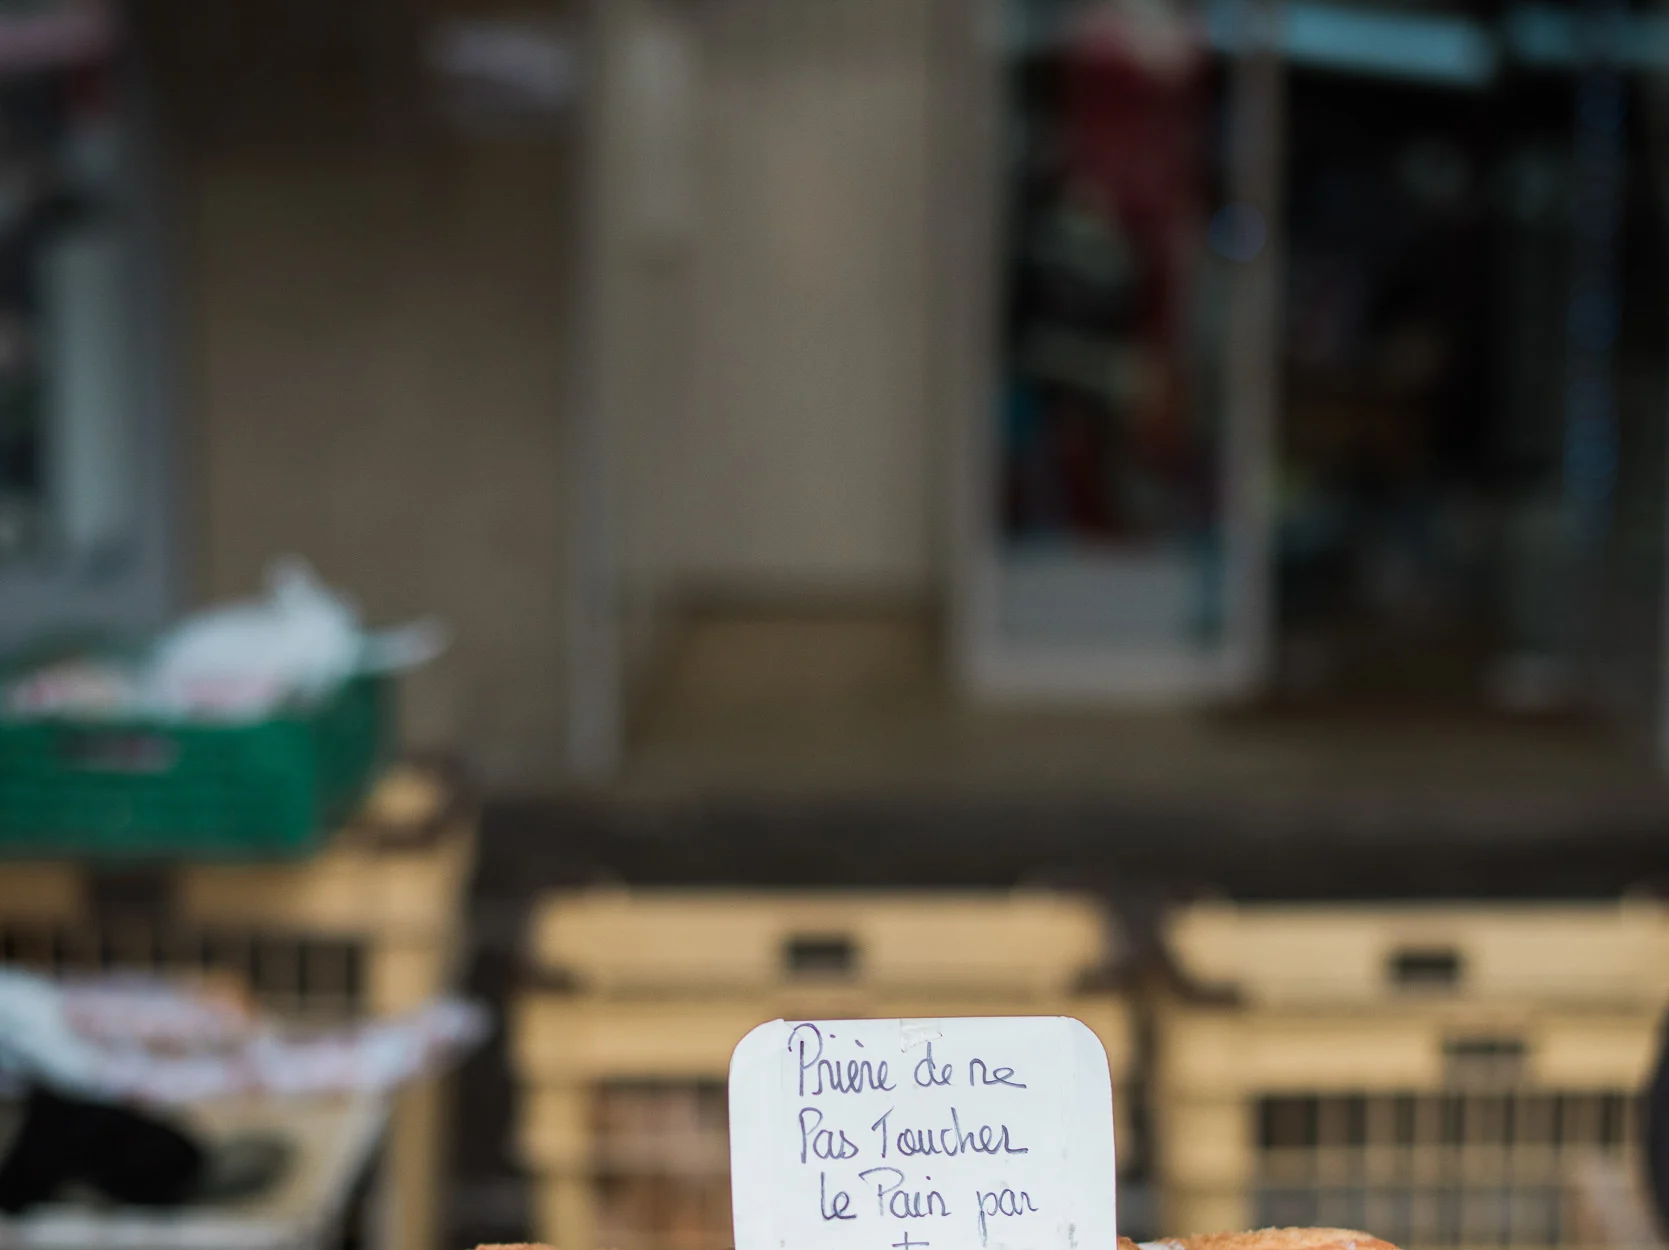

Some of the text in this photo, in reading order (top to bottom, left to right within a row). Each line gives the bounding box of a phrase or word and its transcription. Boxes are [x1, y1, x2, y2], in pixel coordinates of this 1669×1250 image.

[788, 1023, 1027, 1097] Prière de ne
[799, 1106, 1029, 1164] Pas Toucher
[858, 1166, 952, 1217] Pain
[976, 1187, 1039, 1247] par
